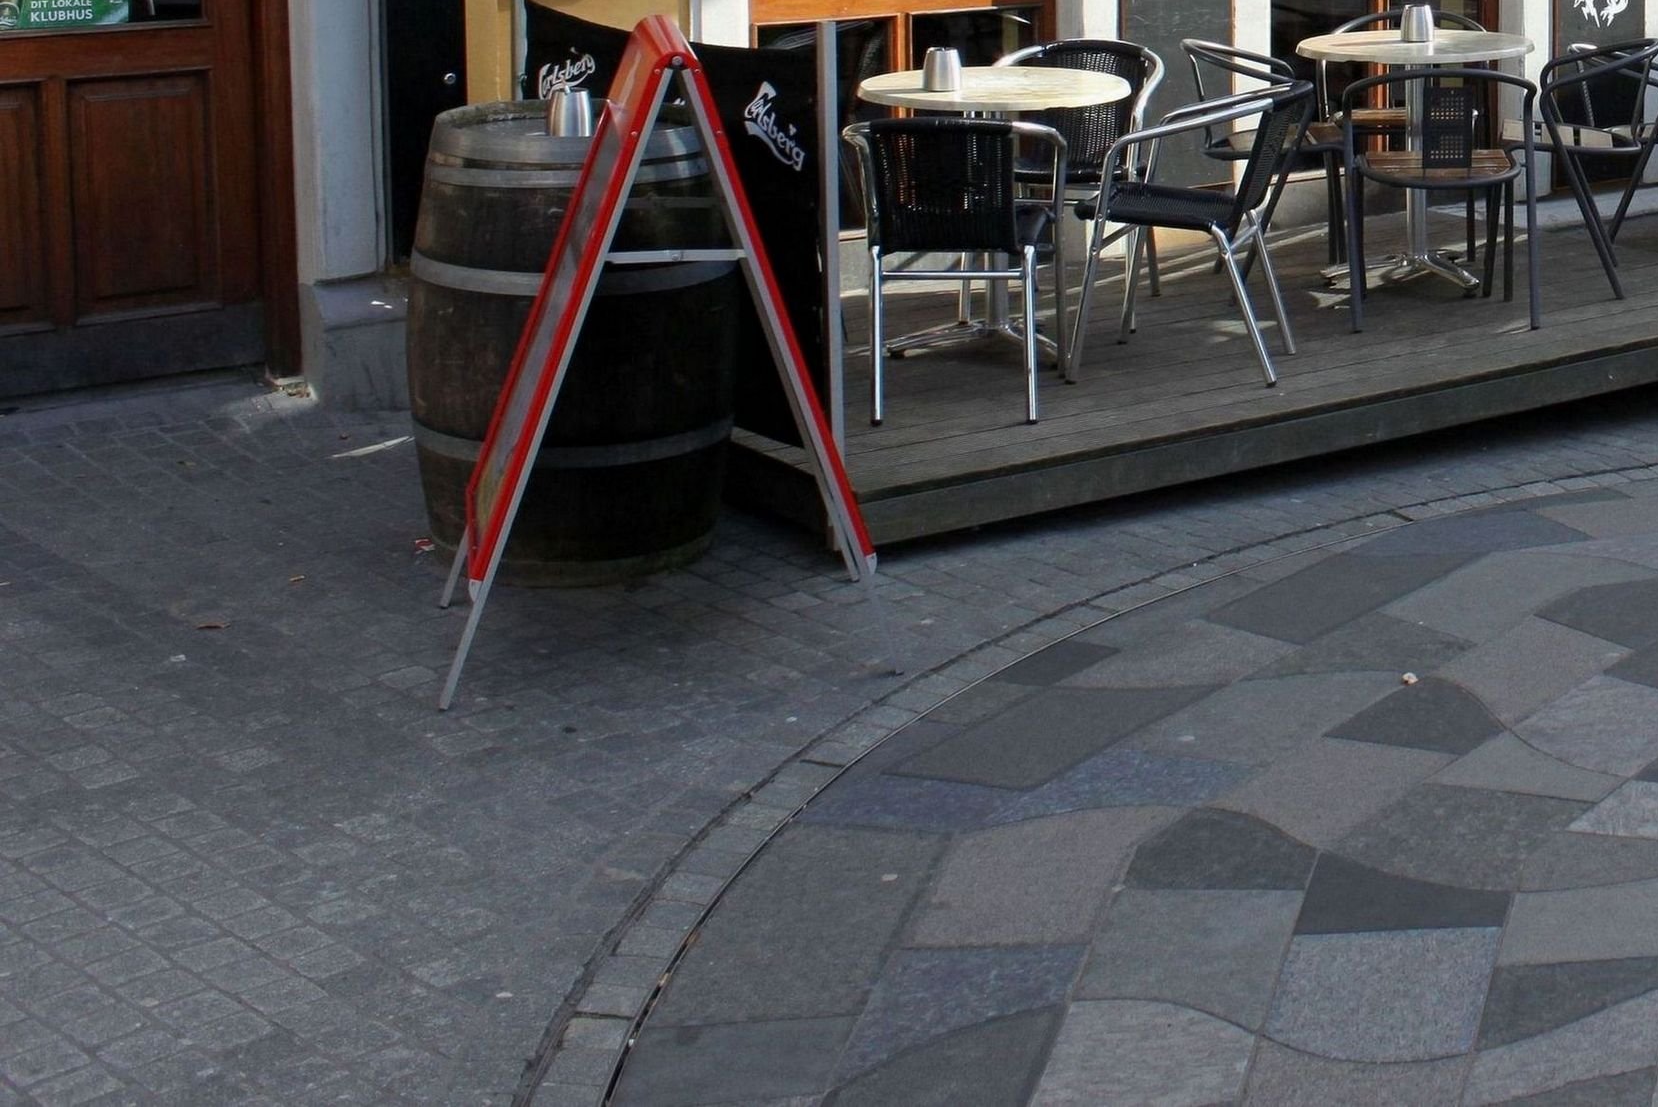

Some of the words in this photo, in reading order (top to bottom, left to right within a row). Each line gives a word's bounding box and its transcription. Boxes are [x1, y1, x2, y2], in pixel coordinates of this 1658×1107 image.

[30, 0, 48, 9] DIT
[30, 9, 94, 23] KLUBHUS
[538, 51, 596, 100] Carlsberg
[744, 80, 806, 172] Carlsberg
